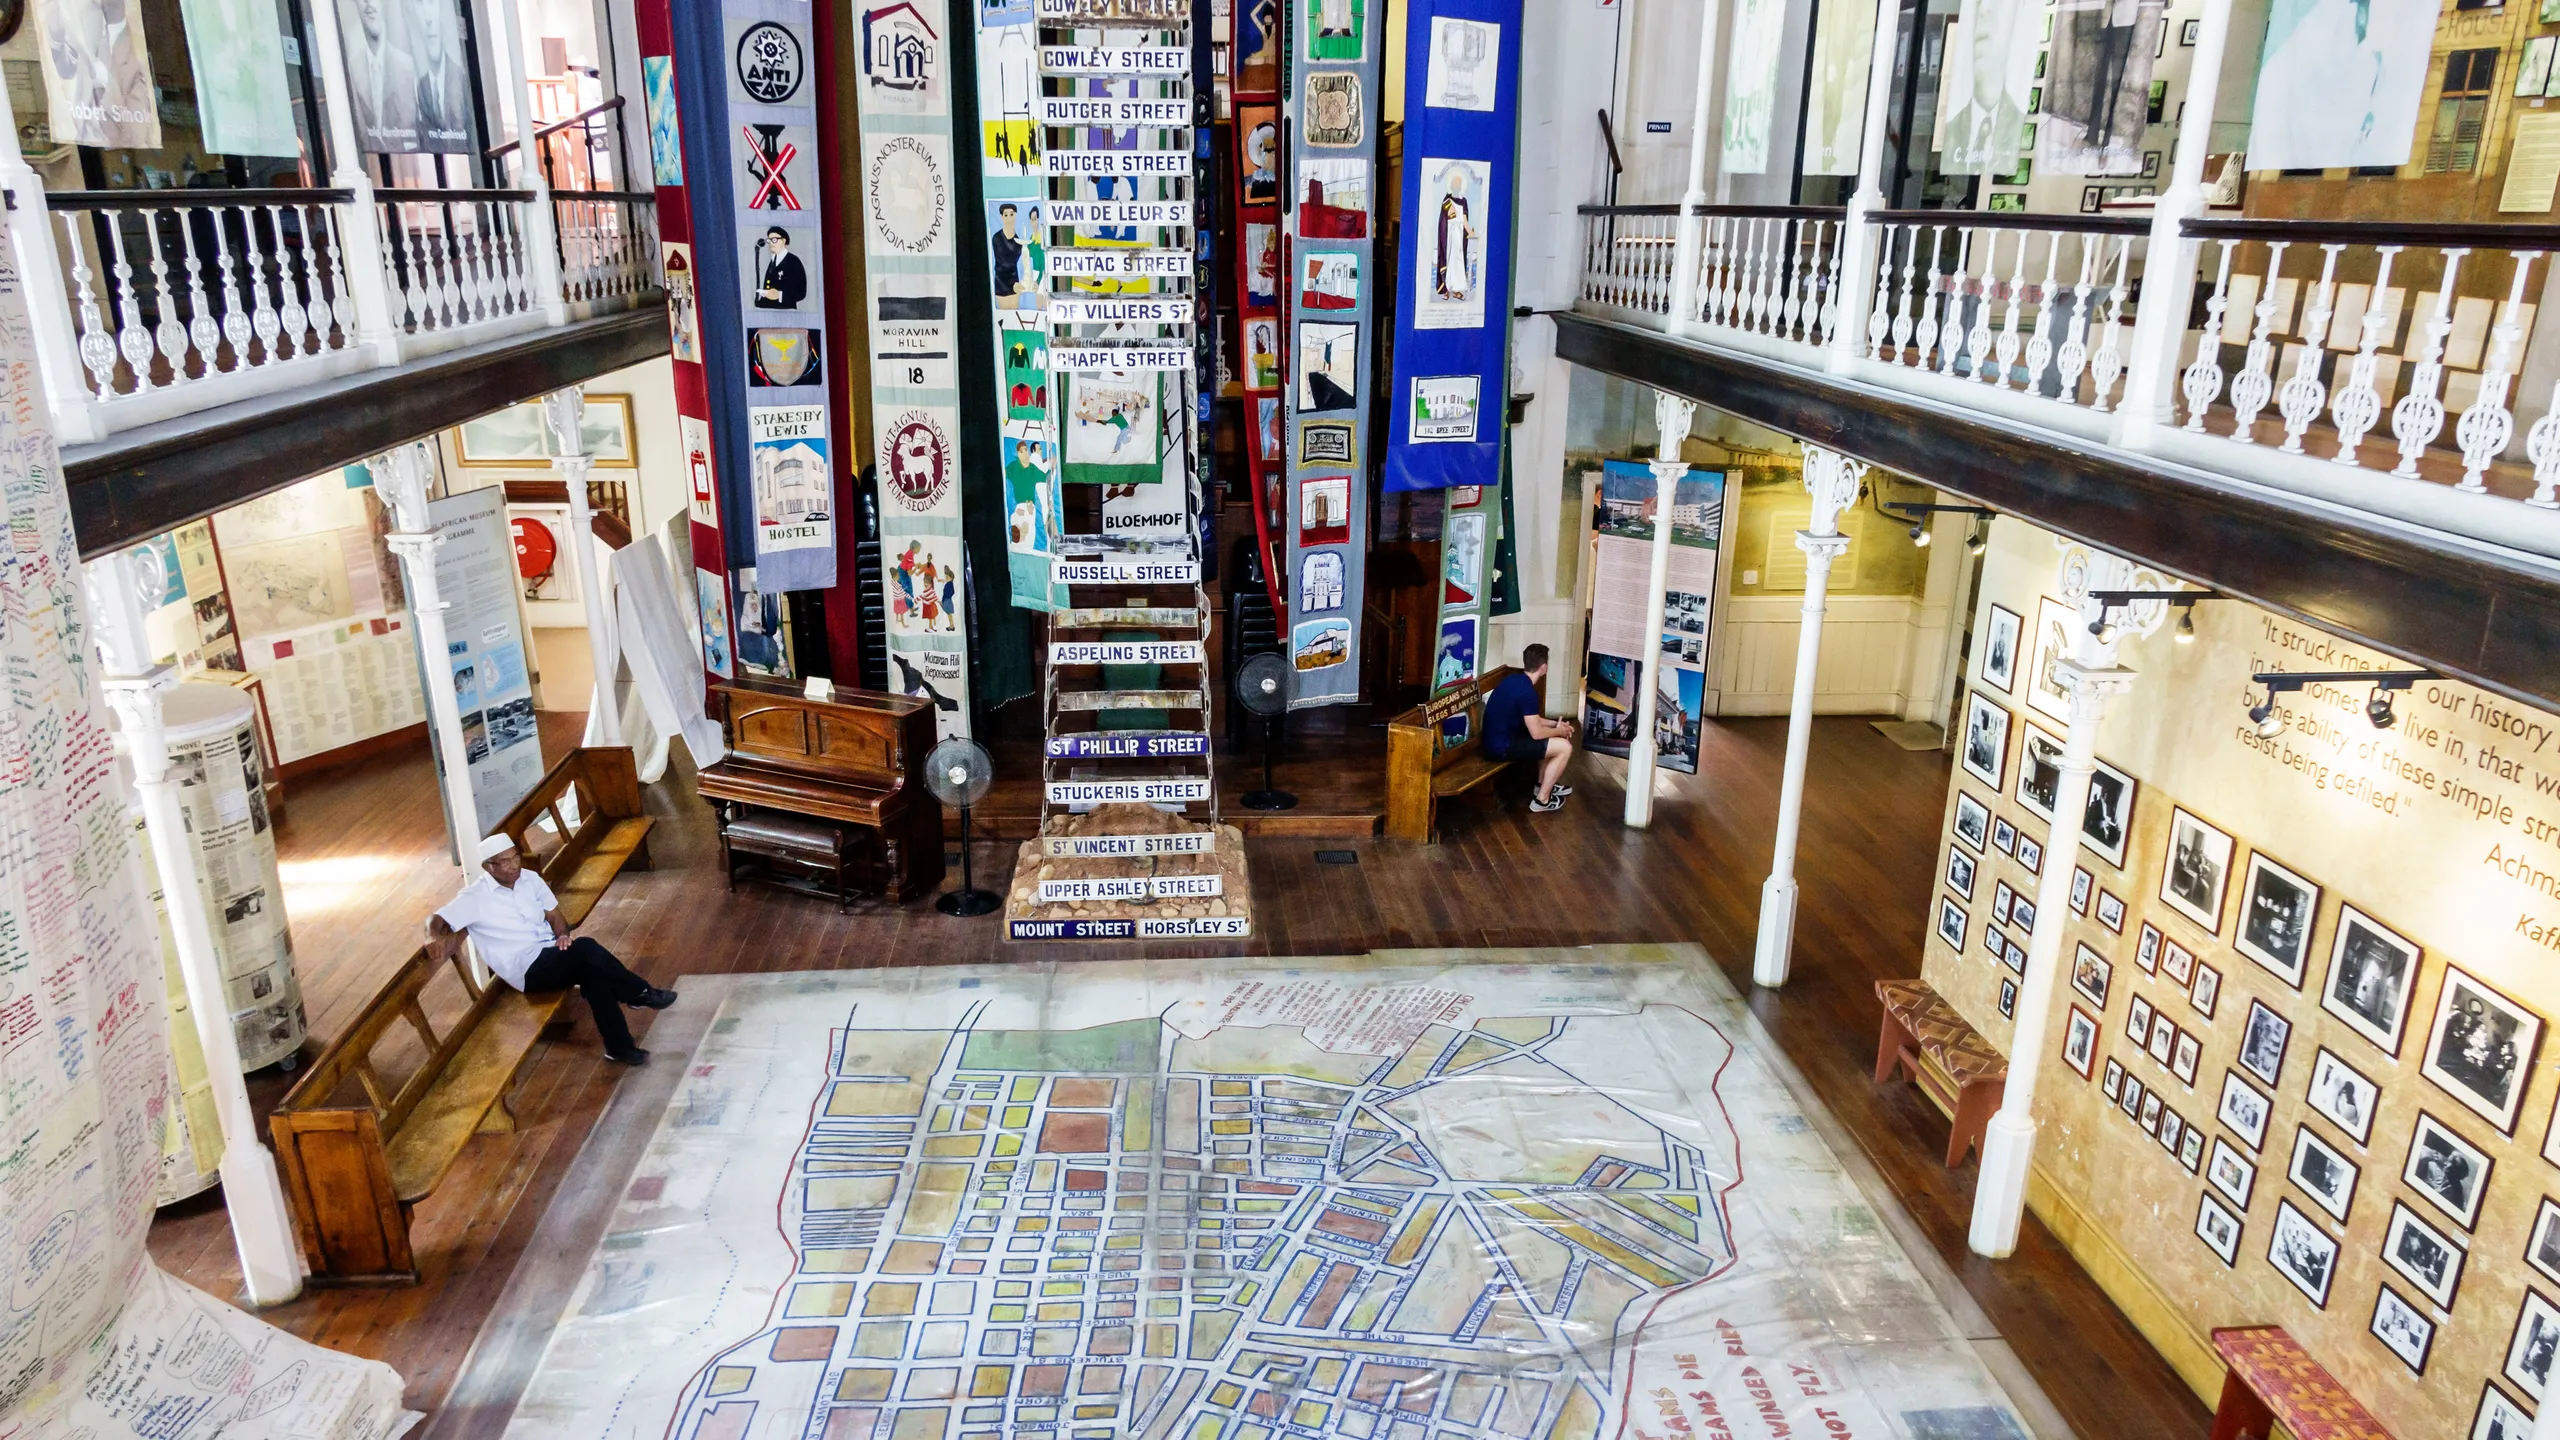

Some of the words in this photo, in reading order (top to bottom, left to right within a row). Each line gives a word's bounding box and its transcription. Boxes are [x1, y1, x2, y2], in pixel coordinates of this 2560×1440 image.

[1044, 51, 1112, 67] COWLEY
[1122, 52, 1184, 68] STREET
[747, 63, 790, 80] ANTI
[1047, 103, 1112, 118] RUTGER
[1121, 104, 1186, 119] STREET
[877, 137, 915, 165] NOSTER
[916, 142, 936, 172] EUM
[1050, 155, 1113, 171] RUTGER
[1123, 156, 1186, 171] STREET
[871, 164, 885, 221] AGNUS
[916, 174, 945, 252] SEQUAMUR
[1052, 206, 1084, 220] VAN
[1091, 206, 1111, 220] DE
[1119, 206, 1163, 221] LEUR
[879, 223, 905, 251] VICIT
[1053, 256, 1115, 271] PONTAC
[1124, 257, 1187, 272] STREET
[1085, 305, 1162, 319] VILLIERS
[883, 328, 939, 337] MORAVIAN
[898, 339, 925, 347] HILL
[1057, 353, 1119, 367] CHAPEL
[1126, 352, 1187, 366] STREET
[908, 368, 924, 384] 18
[754, 411, 822, 425] STAKESBY
[766, 425, 808, 438] LEWIS
[882, 430, 895, 467] VICIT
[893, 411, 929, 432] AGNUS
[929, 415, 951, 466] NOSTER
[887, 478, 905, 505] EUM
[905, 478, 950, 513] SEQUAMUR
[441, 514, 467, 527] AFRICAN
[469, 509, 496, 522] MUSEUM
[1106, 513, 1183, 528] BLOEMHOF
[446, 527, 475, 541] OGRAMME
[769, 527, 820, 540] HOSTEL
[1059, 566, 1129, 580] RUSSELL
[1137, 566, 1193, 579] STREET
[1057, 647, 1133, 661] ASPELING
[1140, 645, 1196, 660] STREET
[2282, 628, 2335, 665] struck
[2340, 653, 2370, 673] me
[923, 653, 949, 665] Moravian
[950, 653, 960, 665] Hill
[925, 666, 960, 680] Repossessed
[1426, 691, 1460, 714] EUROPEANS
[1428, 709, 1448, 725] SLEGS
[2250, 652, 2264, 674] in
[2404, 711, 2438, 748] live
[2445, 731, 2468, 766] in,
[2478, 747, 2524, 784] that
[2427, 685, 2466, 714] our
[2470, 693, 2553, 753] history
[1051, 740, 1072, 755] ST
[1080, 739, 1139, 754] PHILLIP
[1148, 738, 1204, 753] STREET
[2235, 723, 2279, 760] resist
[2282, 741, 2329, 789] being
[2268, 698, 2293, 726] he
[2297, 713, 2349, 756] ability
[2358, 740, 2381, 762] of
[2382, 749, 2435, 791] these
[2440, 773, 2513, 827] simple
[1052, 786, 1140, 800] STUCKERIS
[1145, 784, 1204, 798] STREET
[203, 841, 225, 851] District
[1074, 839, 1136, 854] VINCENT
[1145, 837, 1203, 851] STREET
[1045, 883, 1091, 897] UPPER
[1097, 881, 1153, 897] ASHLEY
[1159, 879, 1215, 893] STREET
[1014, 922, 1065, 936] MOUNT
[1076, 922, 1131, 936] STREET
[1144, 921, 1222, 934] HORSTLEY
[1461, 994, 1475, 1007] OH
[1440, 1002, 1464, 1024] CITY
[1015, 1162, 1031, 1186] CHAPEL
[1340, 1207, 1390, 1222] LAVENDER
[1366, 1332, 1405, 1342] BLYTHE
[1716, 1318, 1751, 1356] BIRD
[1364, 1356, 1428, 1366] HORSTLEY
[1673, 1353, 1704, 1380] DIE
[813, 1395, 833, 1427] LOWRY
[1009, 1422, 1070, 1430] JOHNSON
